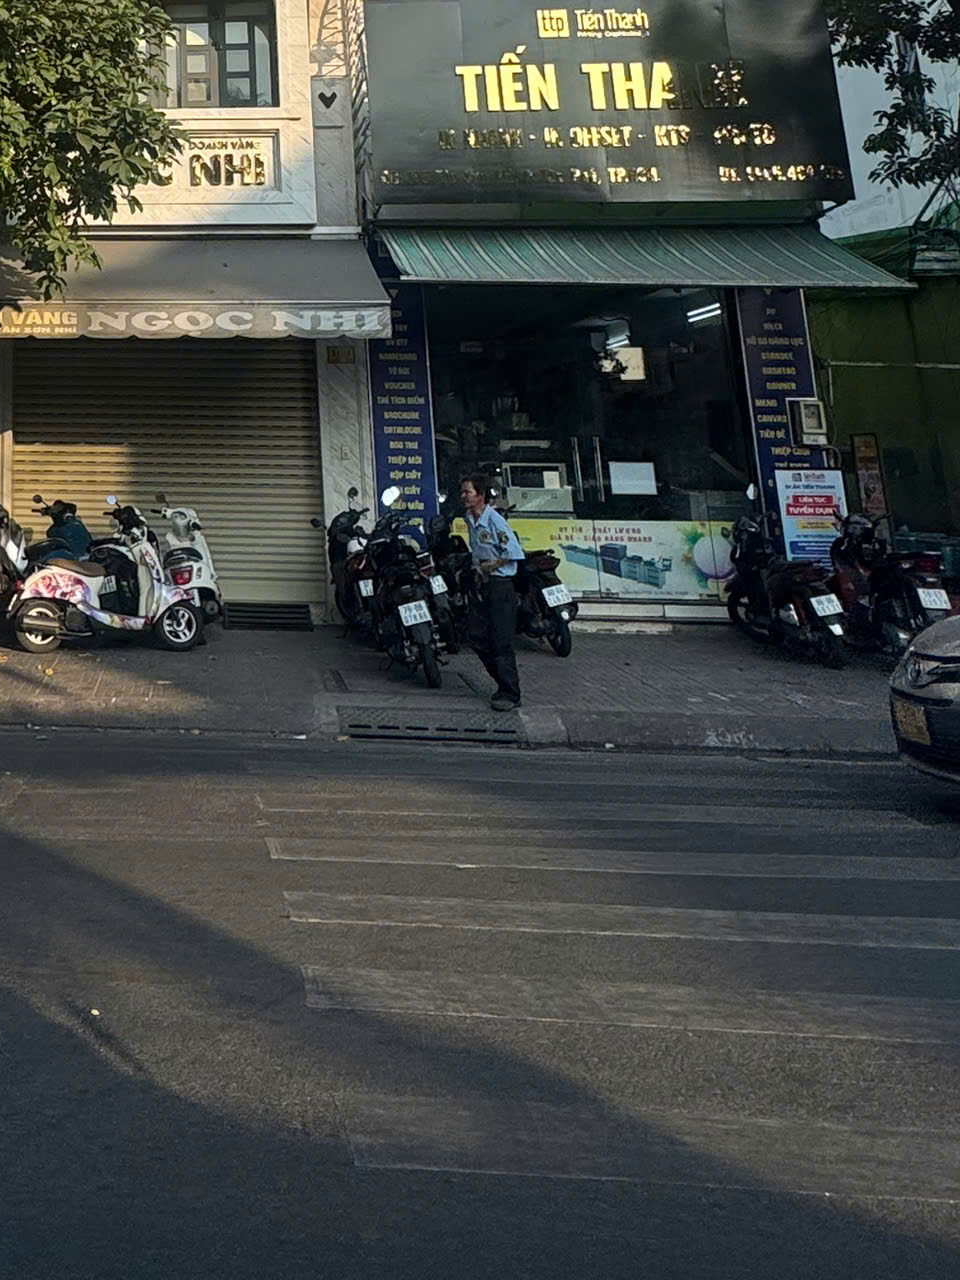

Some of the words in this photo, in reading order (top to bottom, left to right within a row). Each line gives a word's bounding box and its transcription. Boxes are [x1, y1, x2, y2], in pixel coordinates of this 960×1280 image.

[455, 45, 559, 112] TIẾN
[569, 125, 633, 148] OFFSET
[654, 124, 690, 148] KTS
[190, 154, 265, 186] NHI
[11, 308, 78, 325] VÀNG
[88, 310, 253, 336] NGỌC
[272, 310, 383, 331] NHI
